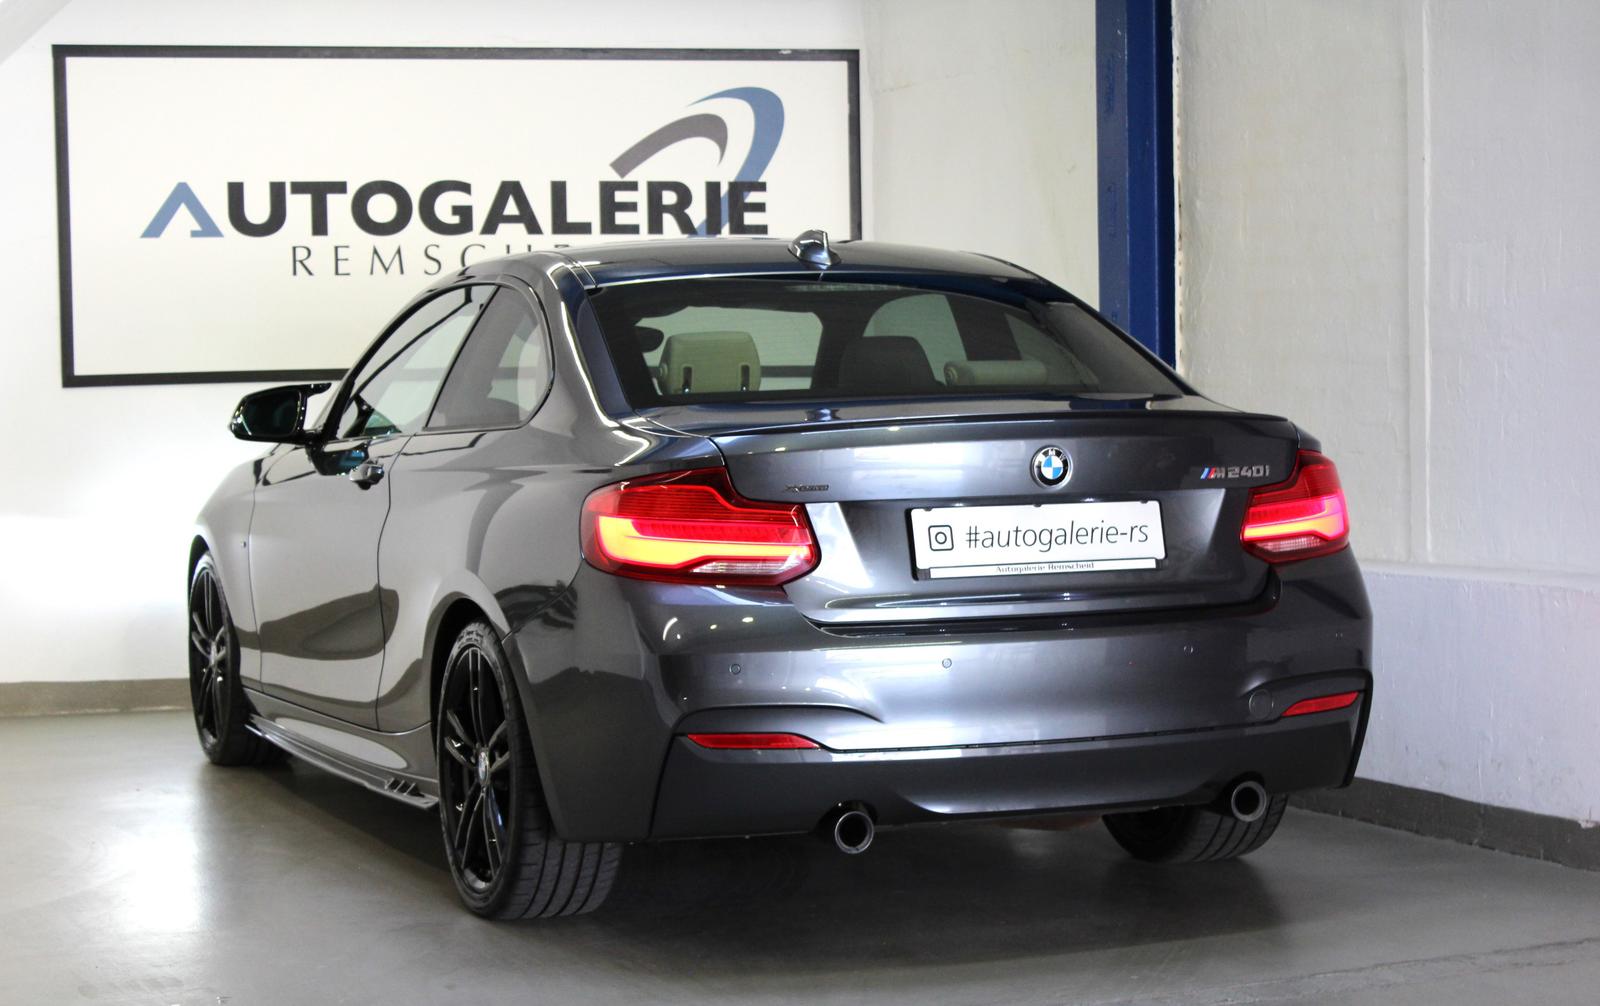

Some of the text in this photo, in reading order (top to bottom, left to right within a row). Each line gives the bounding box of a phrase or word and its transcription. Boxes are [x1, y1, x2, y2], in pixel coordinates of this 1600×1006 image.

[140, 179, 769, 238] AUTOGALERIE
[291, 244, 570, 276] REMSC
[965, 520, 1149, 553] #autogalerie-rs
